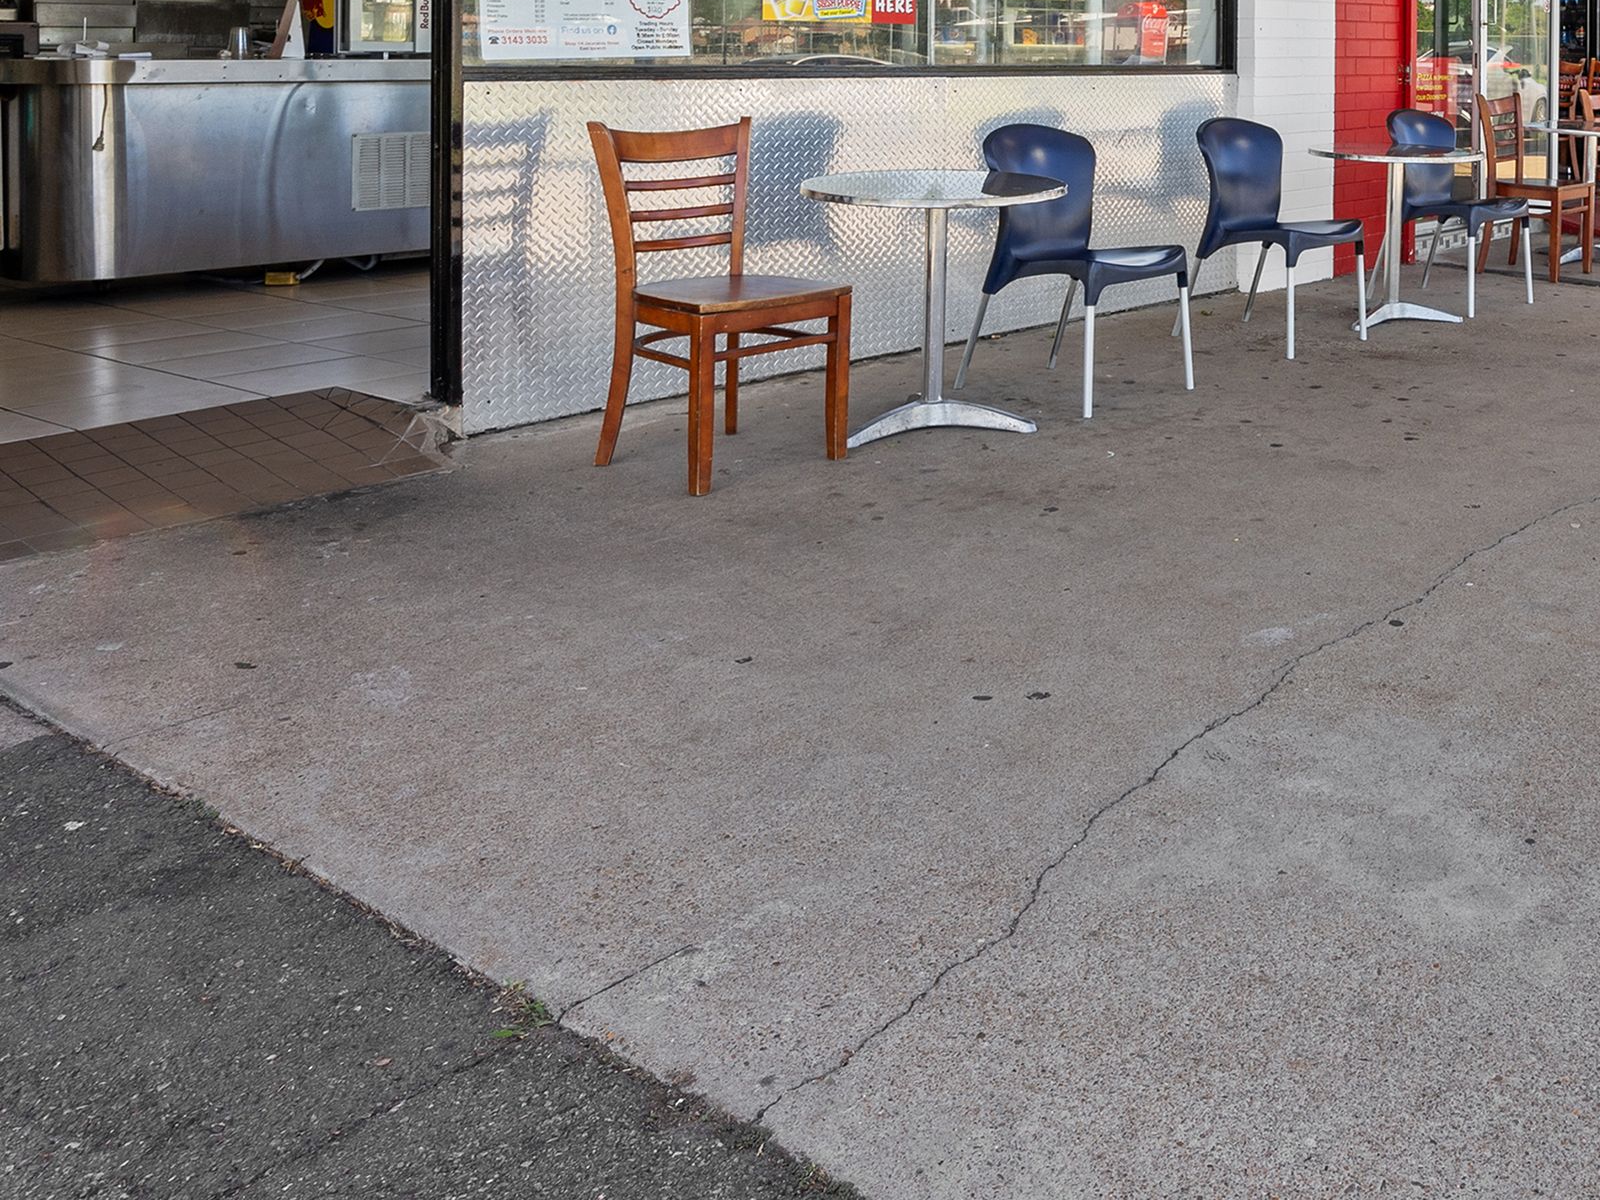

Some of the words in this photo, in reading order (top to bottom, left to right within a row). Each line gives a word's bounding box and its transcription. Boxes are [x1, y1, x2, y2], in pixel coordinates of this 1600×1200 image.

[420, 12, 429, 30] Red
[561, 26, 580, 34] Find
[501, 35, 524, 45] 3143
[526, 35, 548, 45] 3033
